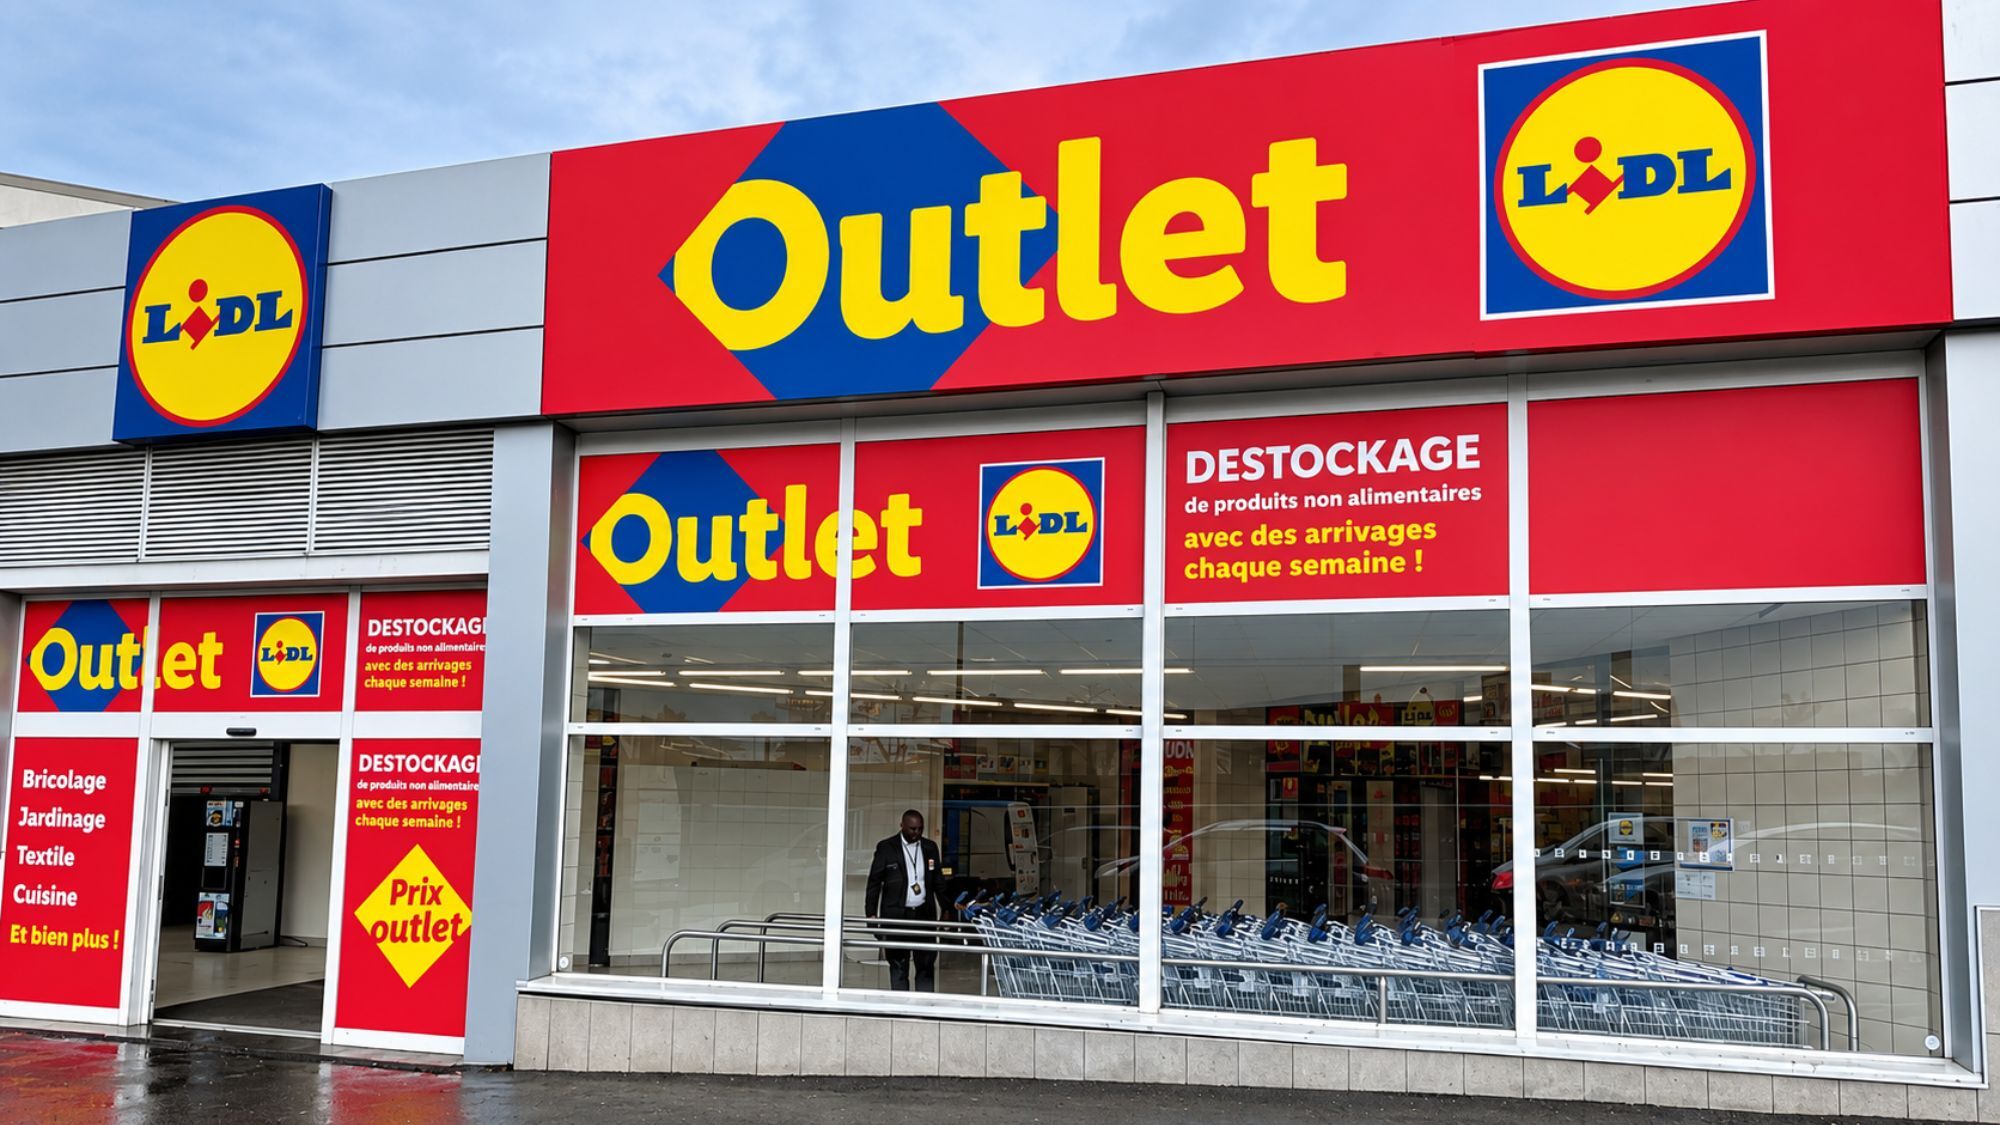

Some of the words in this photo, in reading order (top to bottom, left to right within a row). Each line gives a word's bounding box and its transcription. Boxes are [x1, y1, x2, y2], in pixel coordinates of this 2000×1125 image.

[674, 136, 1347, 351] Outlet
[1186, 434, 1481, 484] DESTOCKAGE
[1184, 497, 1209, 514] de
[1214, 491, 1298, 516] produits
[1304, 491, 1343, 508] non
[1347, 483, 1482, 507] alimentaires
[590, 484, 922, 585] Outlet
[1184, 527, 1243, 549] avec
[1250, 523, 1297, 547] des
[1304, 519, 1437, 547] arrivages
[1184, 557, 1282, 583] chaque
[1289, 550, 1406, 577] semaine
[1414, 549, 1424, 572] !
[365, 643, 377, 653] de
[378, 642, 415, 654] produits
[416, 645, 433, 653] non
[434, 641, 486, 652] alimentaire
[365, 661, 391, 671] avec
[394, 658, 414, 671] des
[416, 658, 472, 674] arrivages
[364, 676, 407, 691] chaque
[409, 675, 459, 688] semaine
[461, 675, 466, 688] !
[22, 769, 107, 795] Bricolage
[357, 779, 368, 789] de
[370, 779, 407, 791] produits
[409, 782, 427, 790] non
[428, 780, 479, 791] alimentaire
[356, 798, 384, 809] avec
[386, 797, 408, 810] des
[410, 797, 468, 814] arrivages
[18, 806, 106, 834] Jardinage
[355, 813, 399, 830] chaque
[402, 814, 454, 828] semaine
[456, 815, 461, 829] !
[16, 845, 75, 867] Textile
[13, 883, 78, 907] Cuisine
[390, 876, 444, 906] Prix
[10, 924, 28, 944] Et
[30, 925, 68, 947] bien
[71, 928, 110, 952] plus
[113, 929, 120, 950] !
[370, 910, 463, 944] outlet
